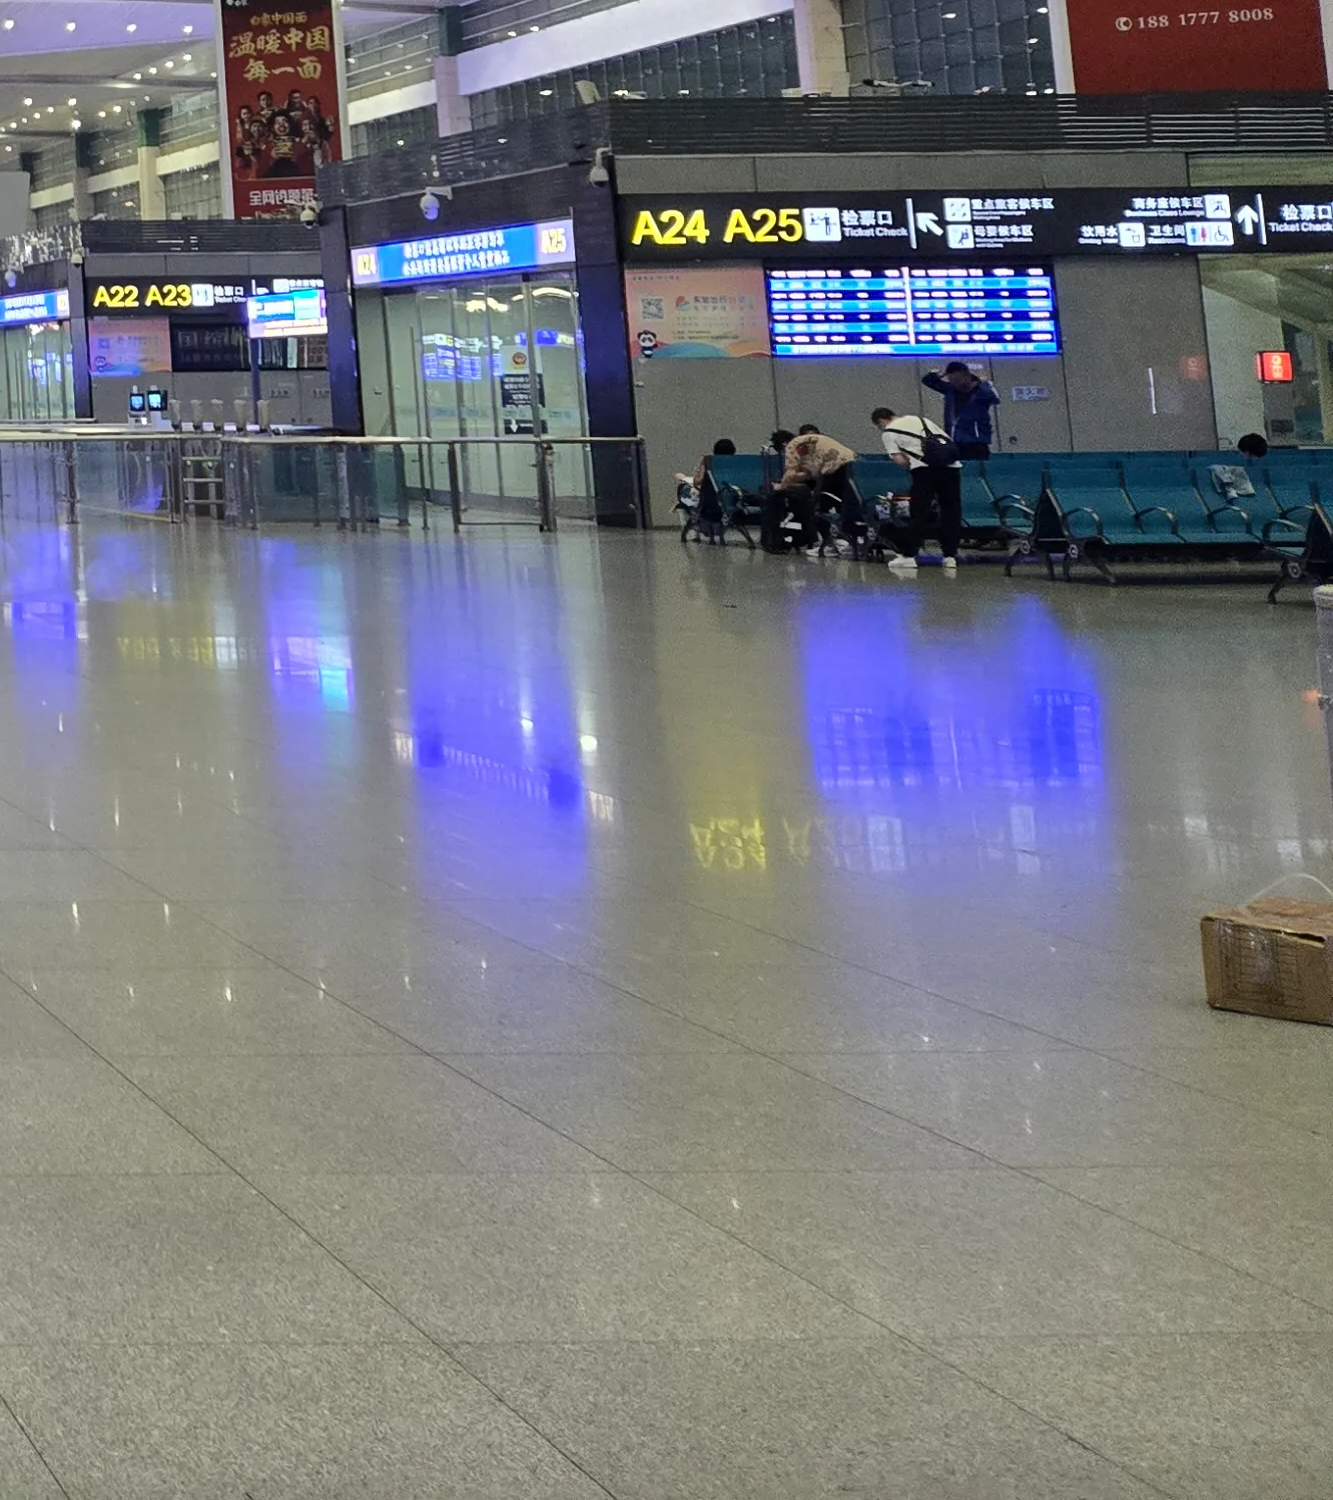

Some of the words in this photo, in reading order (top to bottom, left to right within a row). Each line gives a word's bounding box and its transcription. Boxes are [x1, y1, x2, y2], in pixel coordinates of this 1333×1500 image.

[1137, 15, 1169, 29] 188
[1179, 11, 1220, 26] 1777
[1228, 8, 1274, 23] 8008
[228, 25, 331, 58] 温暖中国
[243, 56, 322, 83] 每一面
[841, 209, 892, 227] 检票口
[1279, 203, 1332, 221] 检票口
[631, 209, 710, 245] A24
[723, 208, 804, 243] A25
[842, 227, 874, 237] Ticket
[875, 227, 909, 237] Check
[1268, 222, 1299, 232] Ticket
[1301, 221, 1333, 232] Check
[93, 285, 140, 307] A22
[145, 284, 192, 307] A23
